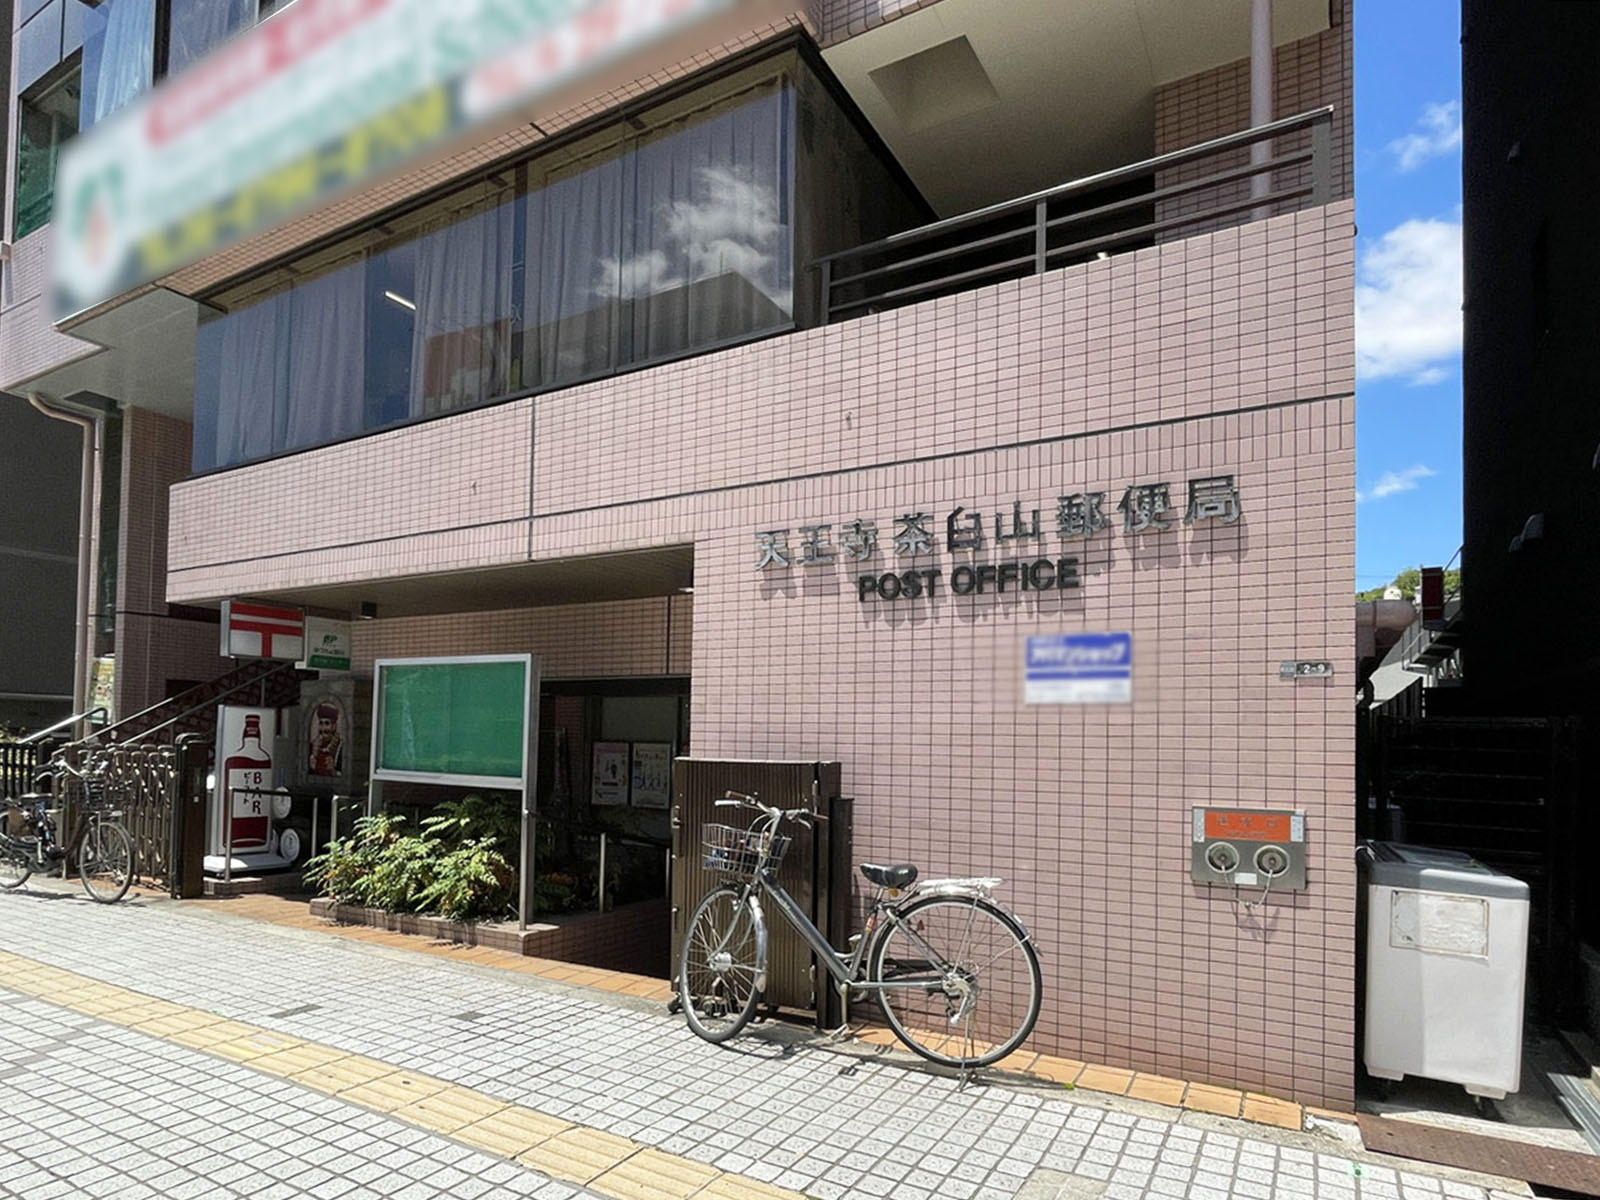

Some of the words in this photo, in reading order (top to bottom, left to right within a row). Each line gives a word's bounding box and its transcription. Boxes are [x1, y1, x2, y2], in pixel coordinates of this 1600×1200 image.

[754, 474, 1243, 571] 天王寺茶臼山郵便局
[858, 569, 941, 601] POST
[951, 557, 1079, 595] OFFICE
[252, 771, 262, 815] BAR
